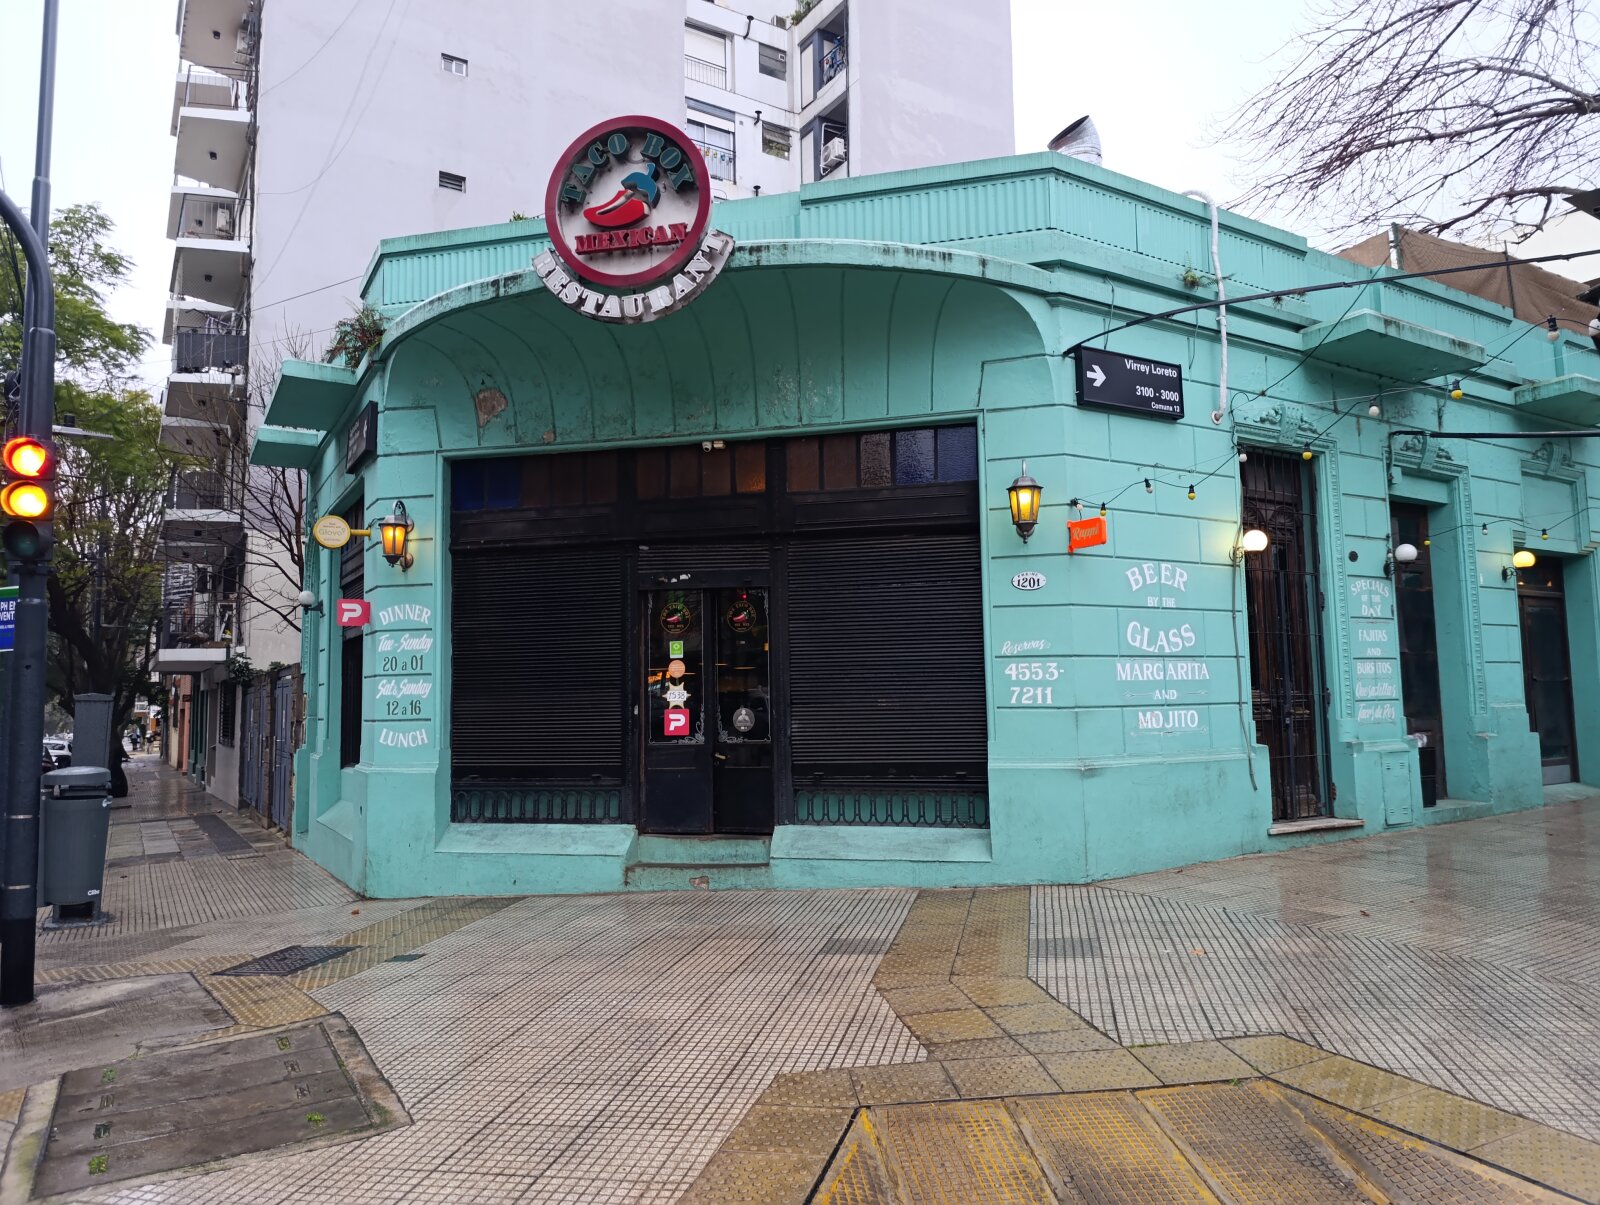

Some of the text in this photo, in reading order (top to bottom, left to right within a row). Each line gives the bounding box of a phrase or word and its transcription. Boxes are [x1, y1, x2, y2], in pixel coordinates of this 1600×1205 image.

[562, 133, 694, 204] TACO BOX
[575, 222, 690, 254] MEXICAN
[532, 229, 734, 319] RESTAURANT
[1124, 359, 1177, 378] Virrey Loreto
[1136, 385, 1154, 398] 3100
[1161, 389, 1179, 401] 3000
[1151, 401, 1173, 411] Comuna
[1017, 577, 1040, 588] 1201
[1125, 562, 1188, 592] BEER
[1351, 580, 1389, 597] SPECIALS
[1147, 596, 1176, 608] BY THE
[379, 604, 431, 625] DINNER
[1362, 605, 1381, 617] DAY
[378, 634, 394, 652] Tue
[397, 634, 433, 653] Sunday
[1127, 621, 1195, 653] GLASS
[1358, 629, 1387, 641] FAJITAS
[1367, 647, 1381, 656] AND
[383, 654, 424, 671] 20 a 01
[1117, 663, 1210, 681] MARGARITA
[396, 679, 432, 698] Sunday
[1010, 687, 1053, 704] 7211
[1154, 690, 1177, 700] AND
[386, 700, 422, 715] 12 a 16
[1138, 710, 1199, 729] MOJITO
[379, 728, 428, 748] LUNCH
